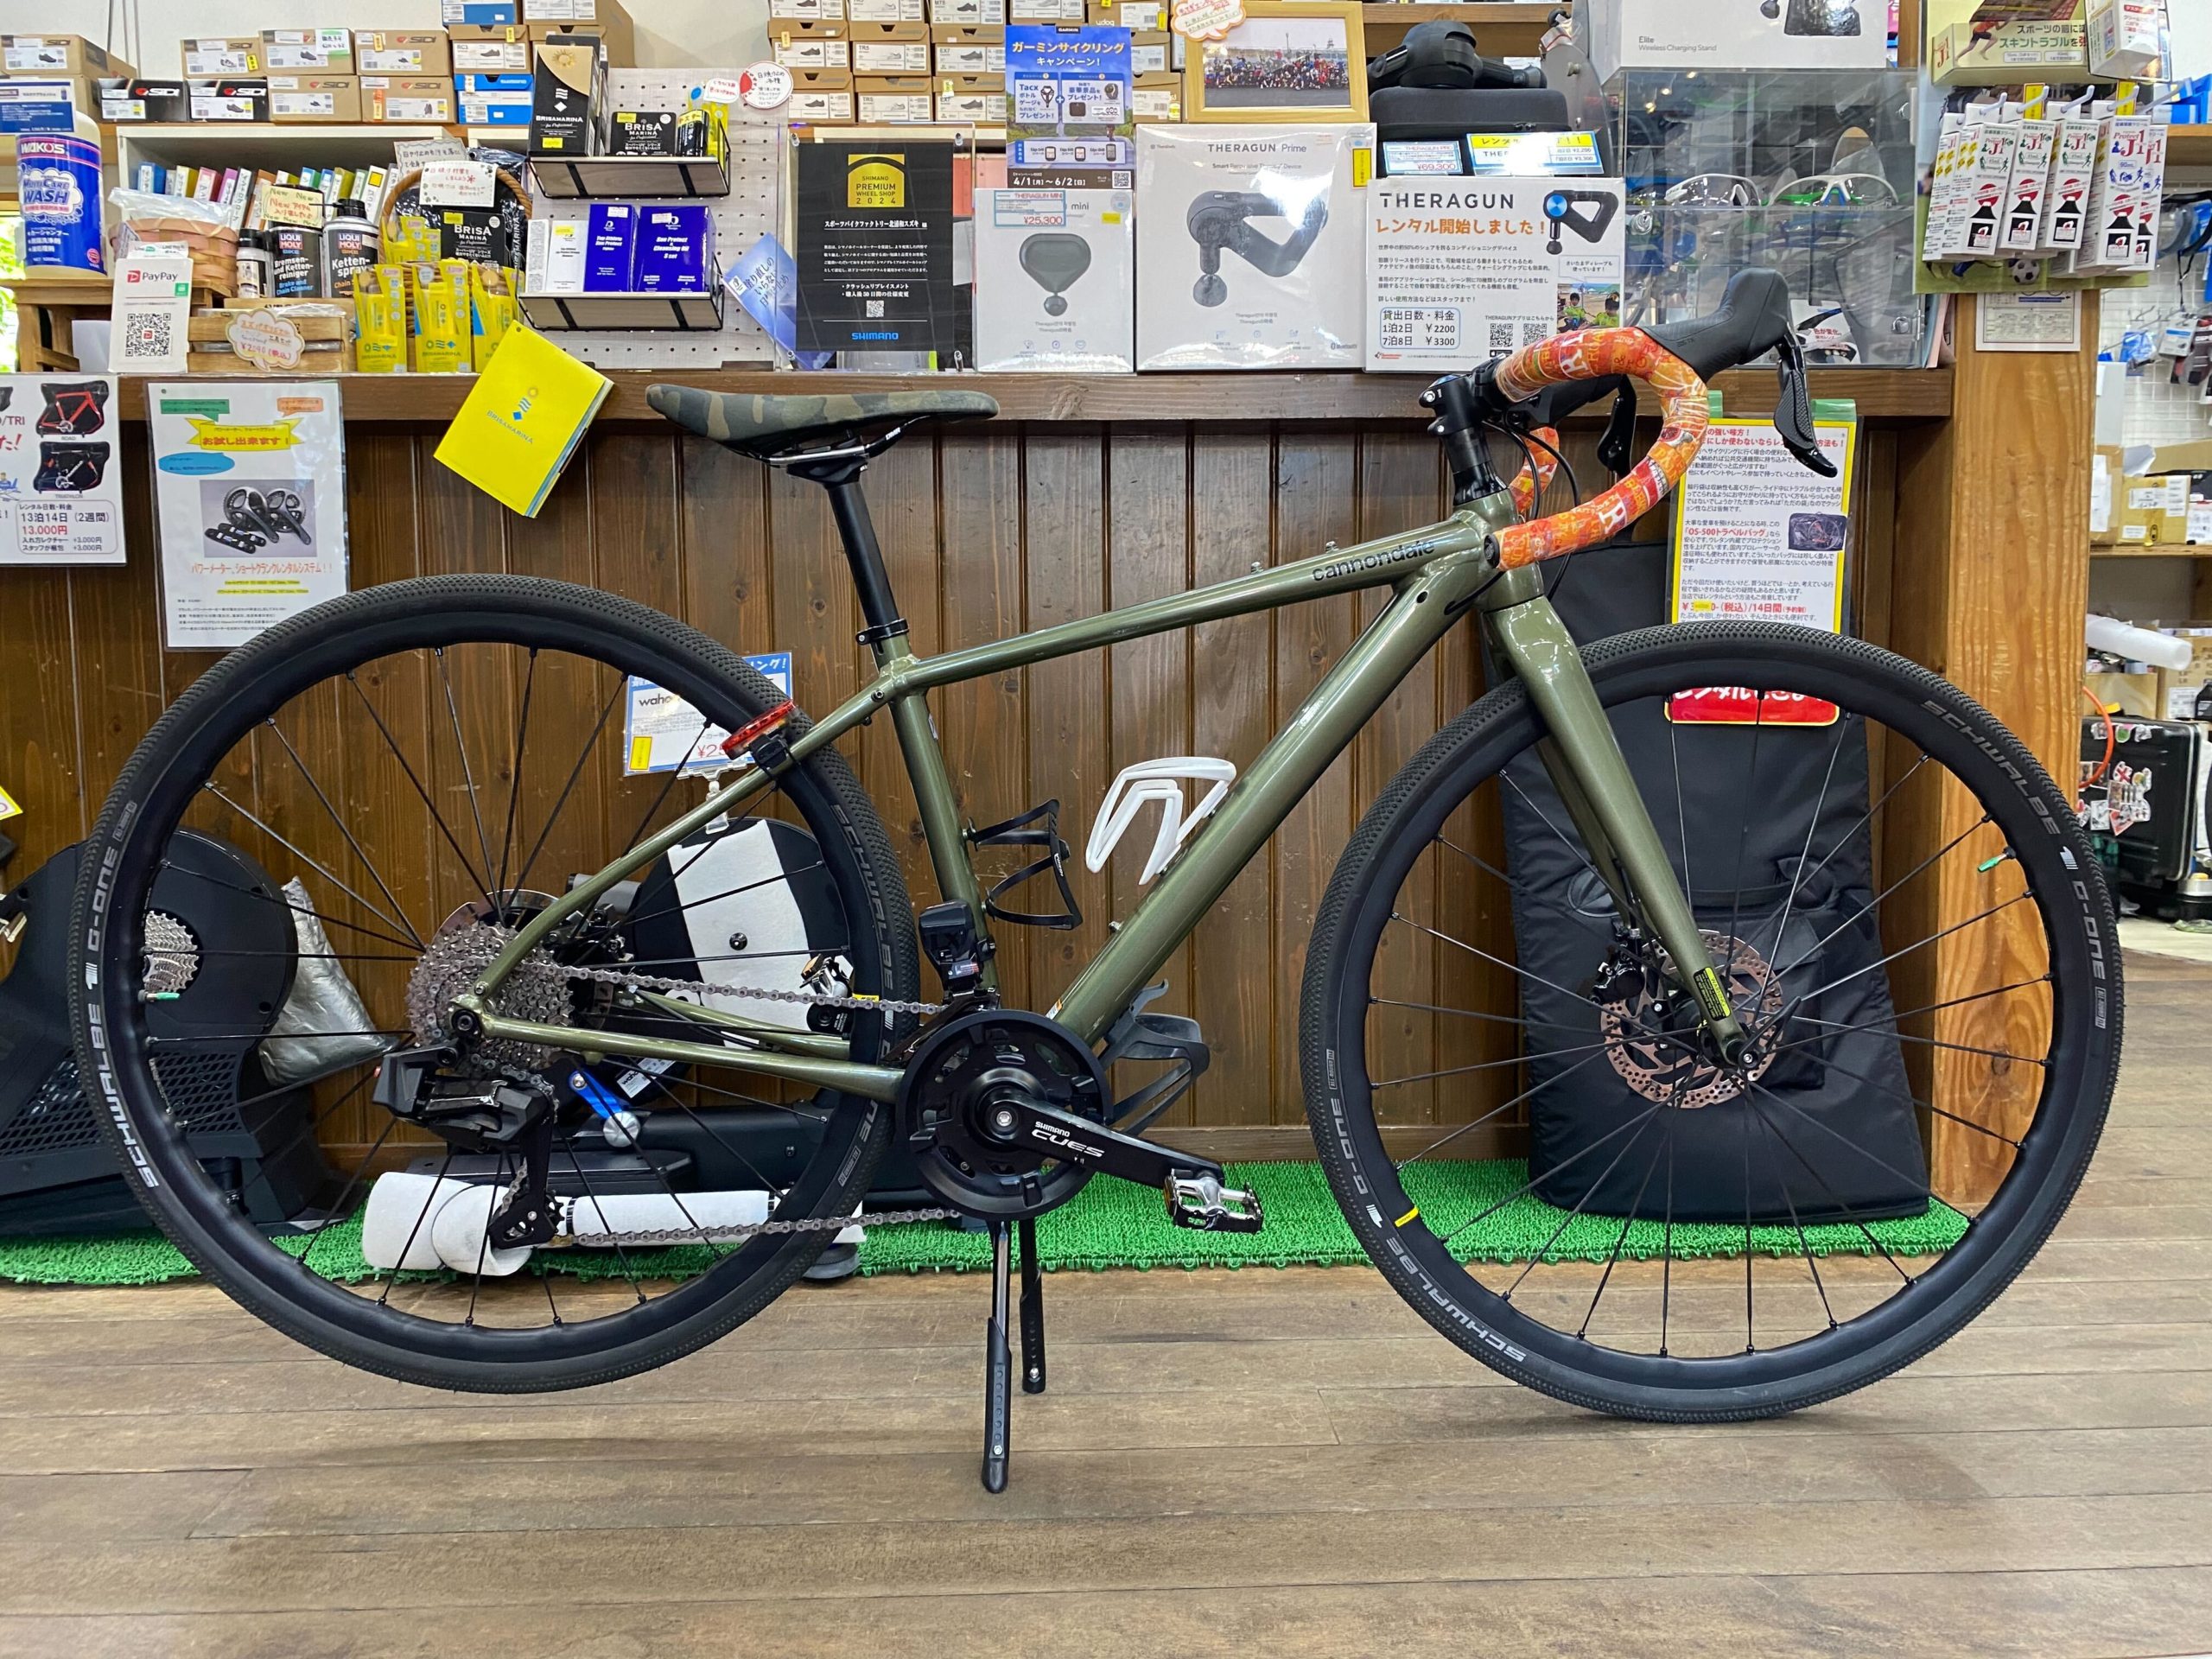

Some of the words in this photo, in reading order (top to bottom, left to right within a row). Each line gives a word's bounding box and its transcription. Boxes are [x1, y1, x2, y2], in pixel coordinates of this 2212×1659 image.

[1013, 41, 1125, 54] ガーミンサイクリング
[1207, 143, 1276, 152] THERAGUN
[1281, 143, 1306, 152] Prime
[23, 190, 68, 205] WASH
[1380, 193, 1514, 209] THERAGUN
[1376, 218, 1546, 234] レンタル開始しました！
[280, 233, 302, 242] LIQUI
[339, 233, 359, 242] LIQUI
[280, 241, 302, 250] MOLY
[339, 241, 361, 250] MOLY
[332, 257, 371, 270] Ketten-
[143, 271, 178, 282] PayPay
[1382, 310, 1455, 321] 貸出日数・料金
[1382, 323, 1413, 333] 1泊2日
[1382, 336, 1413, 346] 7泊8日
[21, 512, 67, 523] 13泊14日
[1312, 540, 1434, 582] cannondale
[639, 693, 679, 707] waho
[1920, 700, 2061, 834] SCHWALBE
[87, 846, 118, 951] G-ONE
[830, 804, 893, 989] SCHWALBE
[2072, 880, 2106, 980] G-ONE
[88, 1003, 159, 1188] SCHWALBE
[1035, 1121, 1071, 1137] SHIMANO
[1031, 1129, 1105, 1157] CUES
[1331, 1098, 1369, 1194] G-ONE
[1386, 1237, 1527, 1362] SCHWALBE
